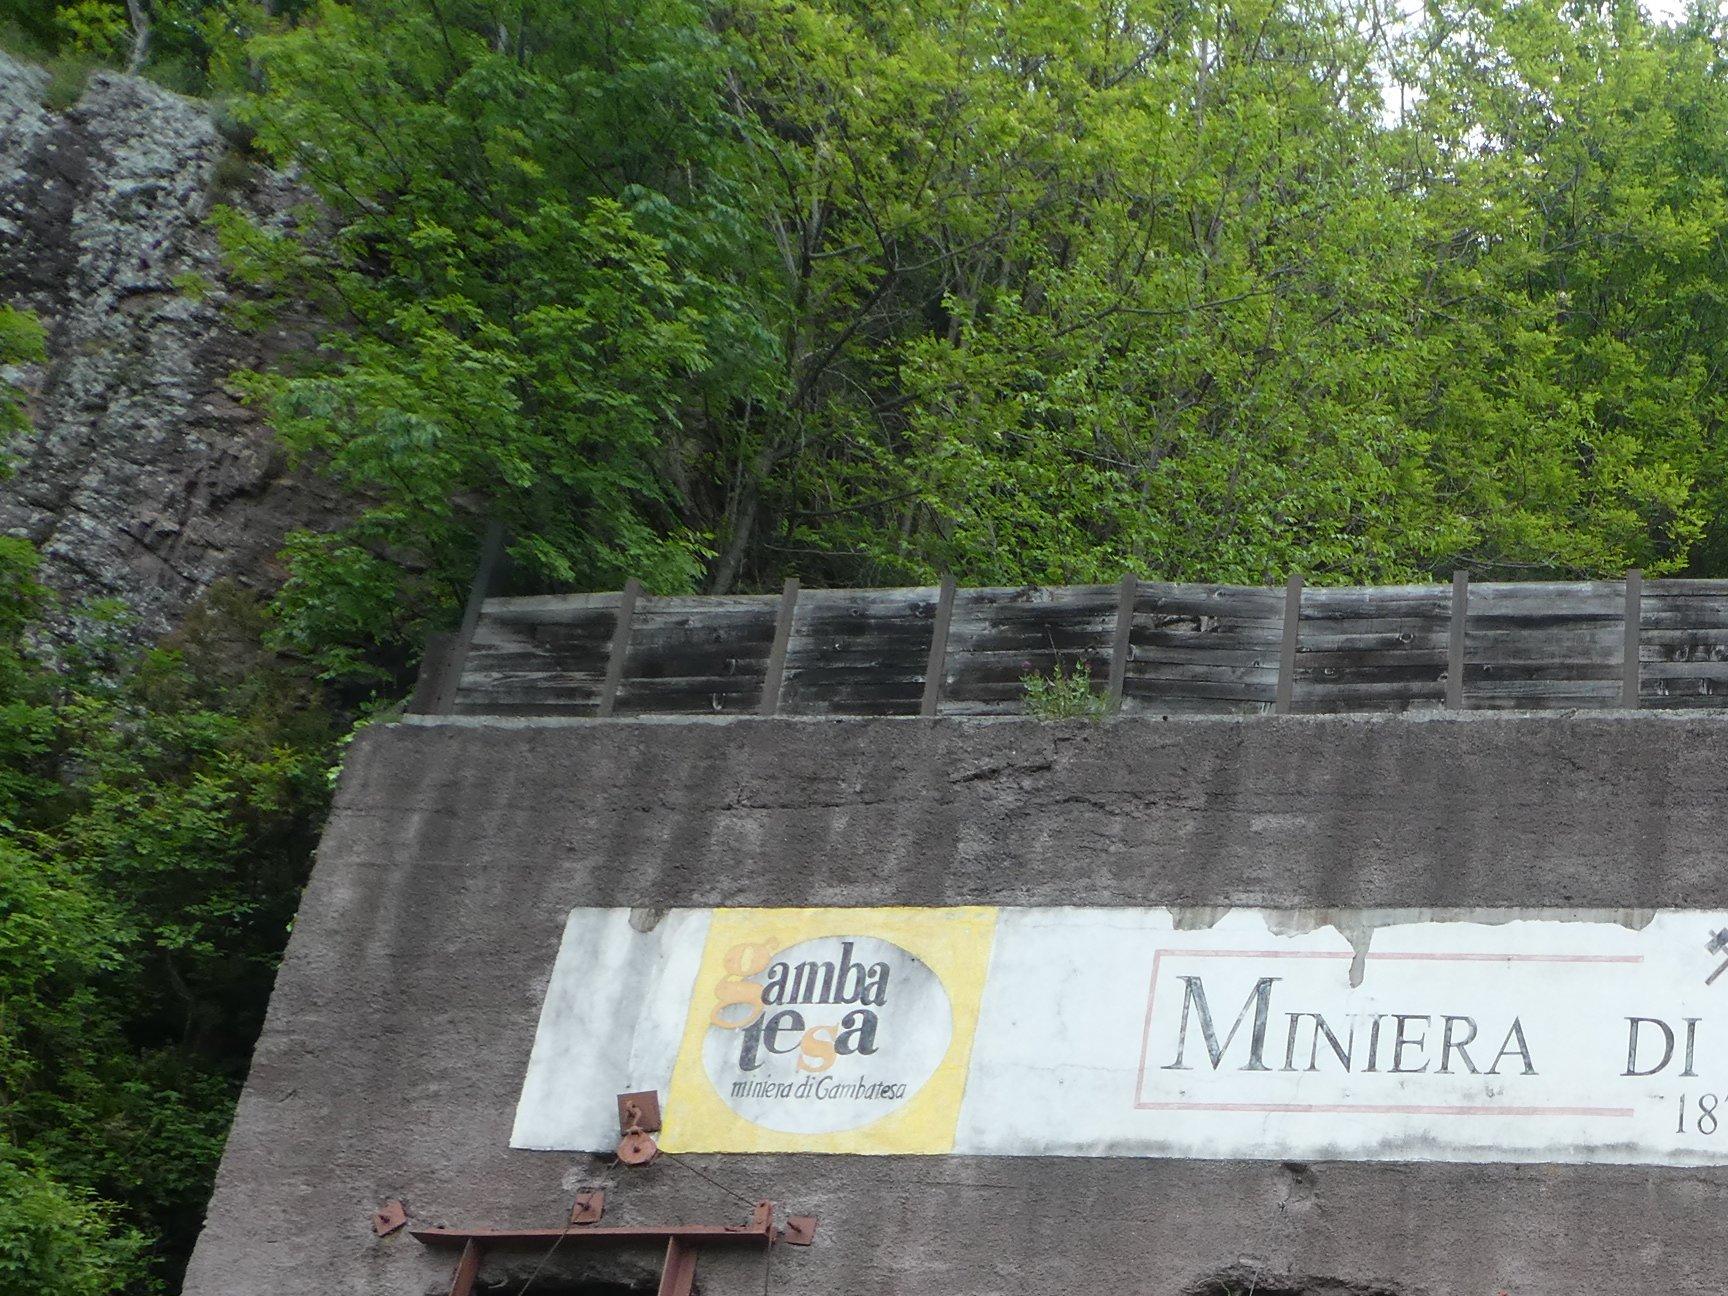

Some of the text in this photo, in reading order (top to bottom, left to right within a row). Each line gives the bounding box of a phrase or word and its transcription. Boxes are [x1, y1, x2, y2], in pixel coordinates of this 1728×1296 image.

[710, 936, 890, 1029] gamba
[738, 1009, 880, 1073] tesa
[1160, 975, 1540, 1076] MINIERA
[1618, 1016, 1703, 1078] DI
[730, 1073, 907, 1100] miniera di Gambatesa
